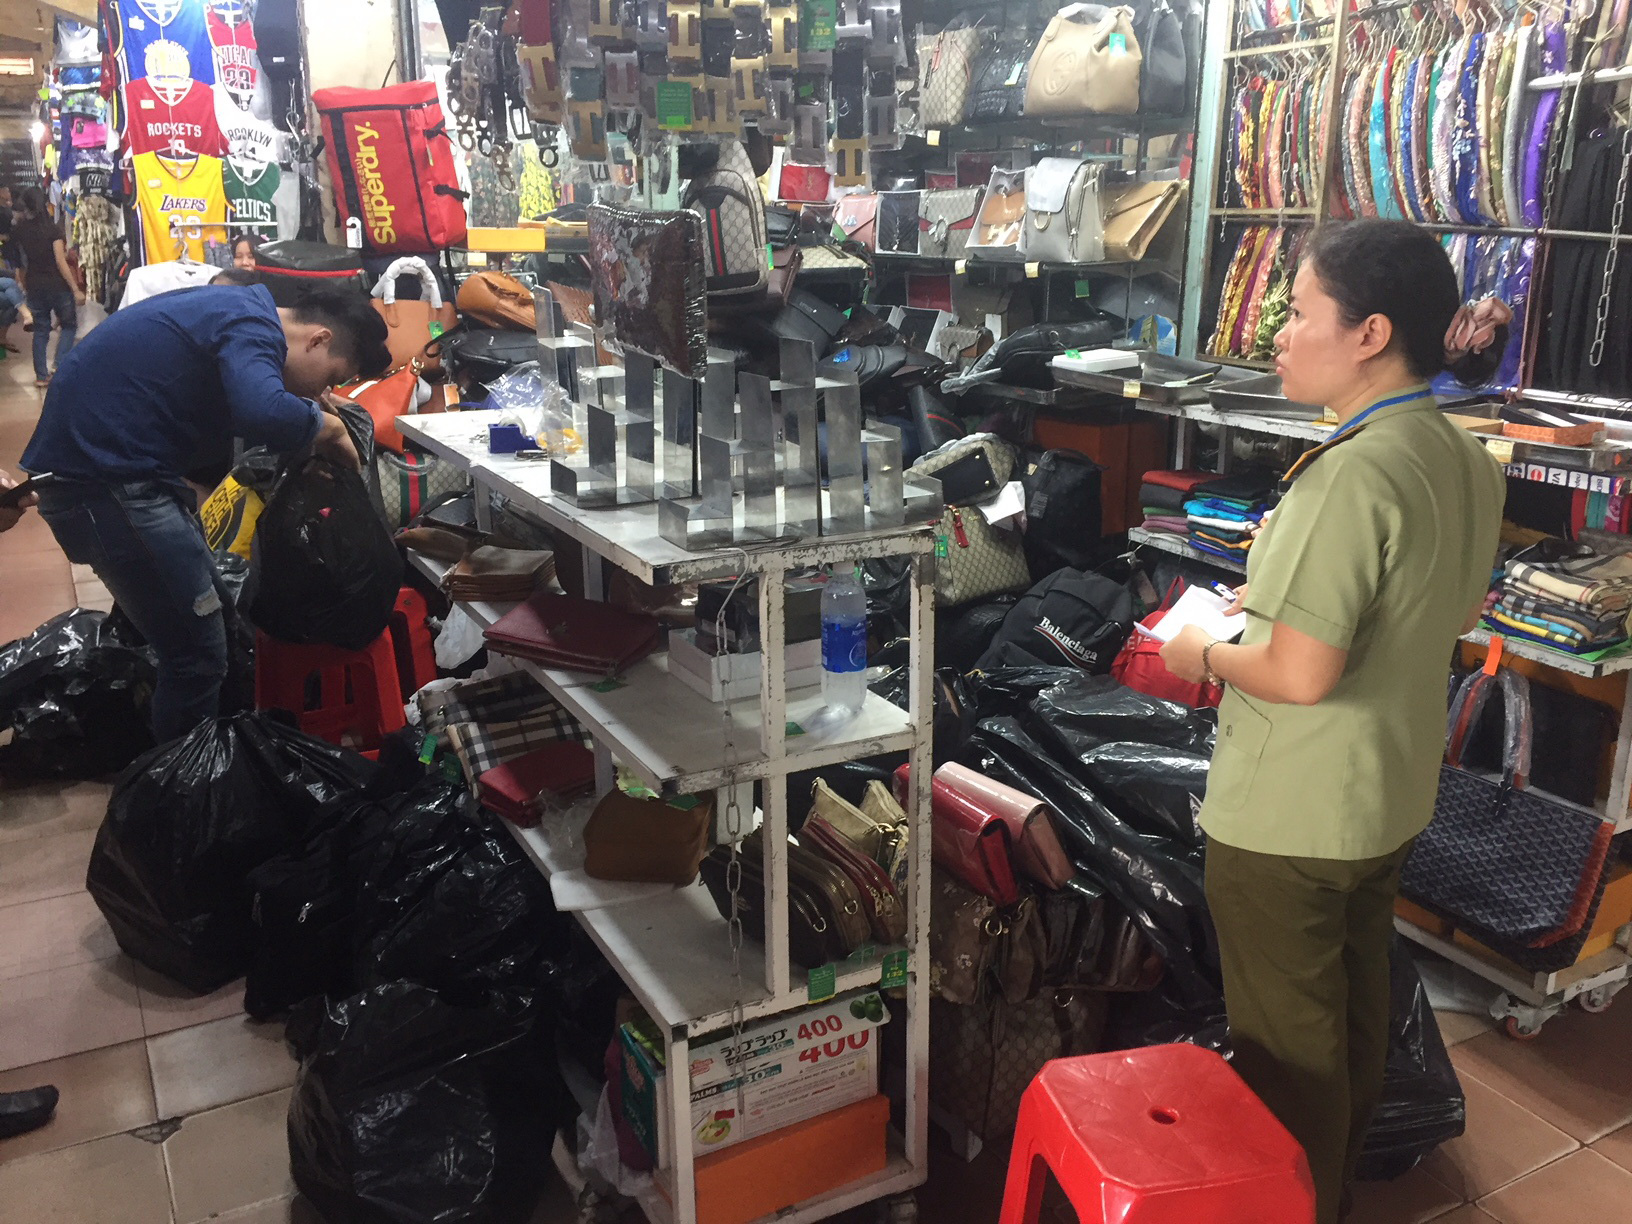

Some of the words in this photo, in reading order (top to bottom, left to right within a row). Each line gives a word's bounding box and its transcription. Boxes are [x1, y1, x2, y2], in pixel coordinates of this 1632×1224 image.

[146, 121, 202, 137] ROCKETS
[225, 126, 273, 148] ROOKLYN
[159, 194, 207, 212] LAKERS
[1038, 616, 1099, 662] Balenciaga
[797, 1014, 843, 1040] 400
[798, 1029, 870, 1063] 400
